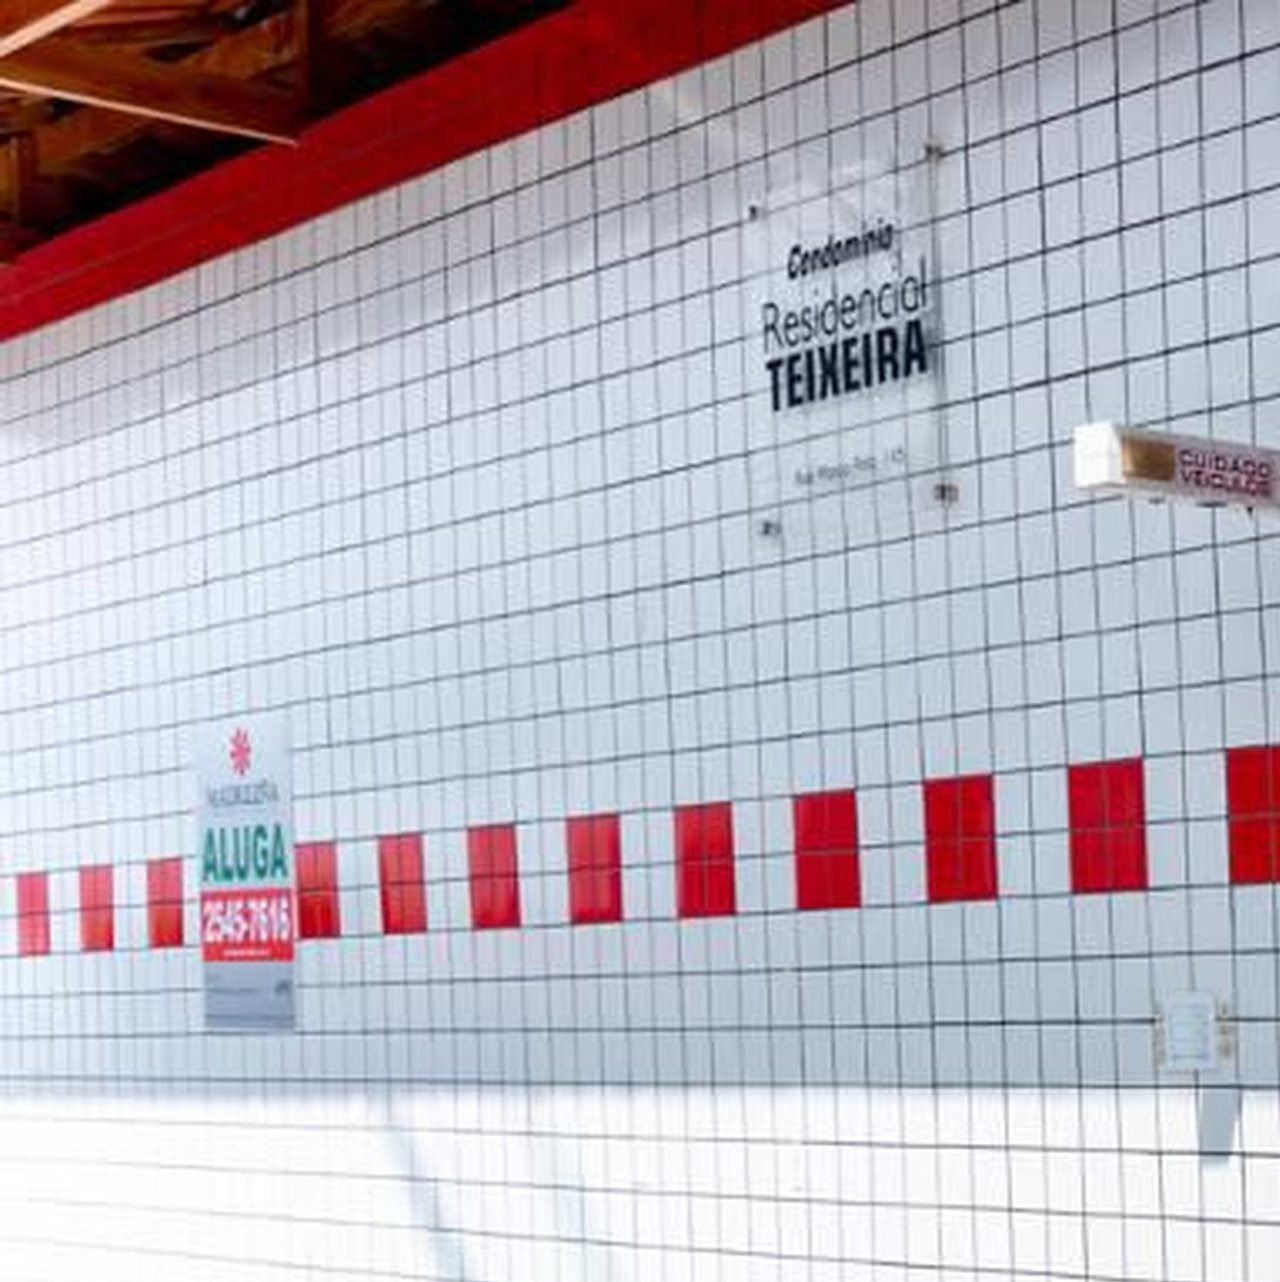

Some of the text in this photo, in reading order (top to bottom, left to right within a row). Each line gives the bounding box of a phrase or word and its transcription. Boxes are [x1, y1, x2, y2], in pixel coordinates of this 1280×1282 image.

[763, 255, 926, 353] Residencial
[766, 319, 927, 412] TEIXEIRA
[1180, 450, 1270, 478] CUIDADO
[202, 822, 288, 882] ALUGA
